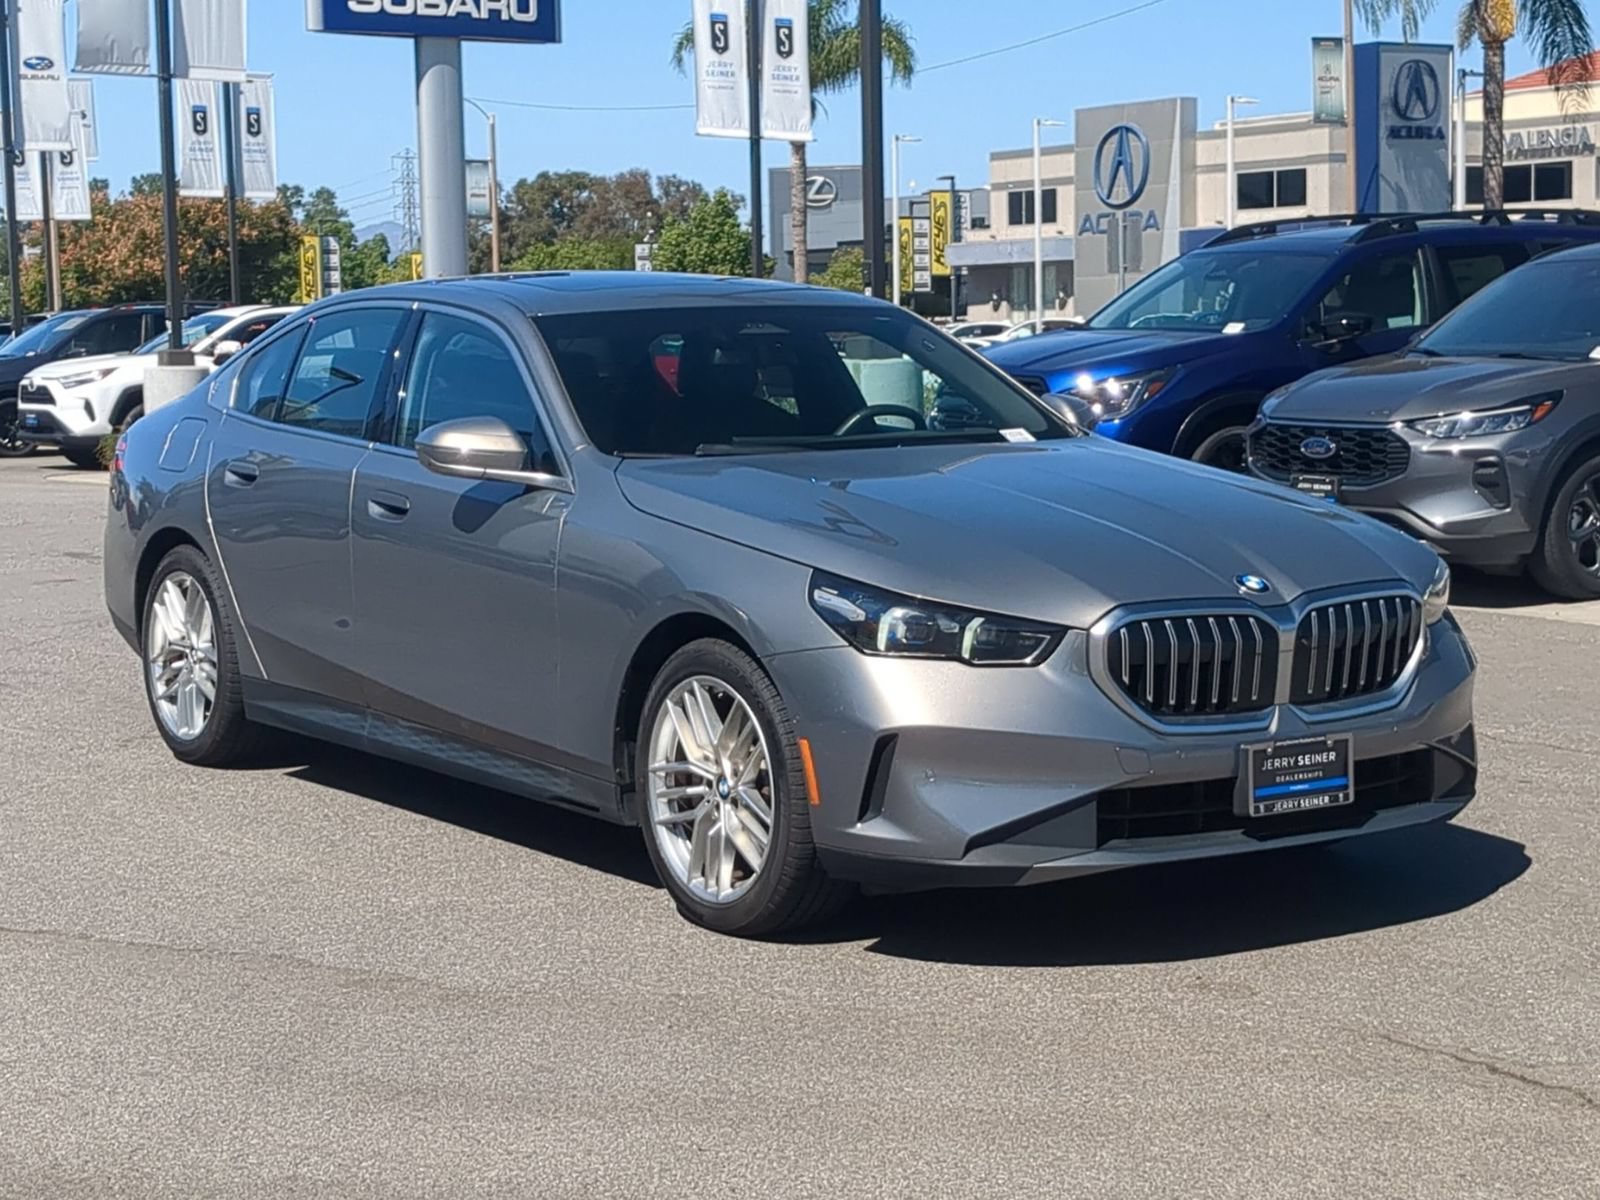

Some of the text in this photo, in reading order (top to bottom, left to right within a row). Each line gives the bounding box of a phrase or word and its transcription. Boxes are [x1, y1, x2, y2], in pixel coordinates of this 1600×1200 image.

[1502, 126, 1591, 151] VALENCIA
[1078, 209, 1160, 236] ACA
[1261, 751, 1336, 771] JERRY SEINER
[1275, 771, 1323, 782] DEALERSHIPS
[1273, 795, 1330, 812] JERRY SEINER
